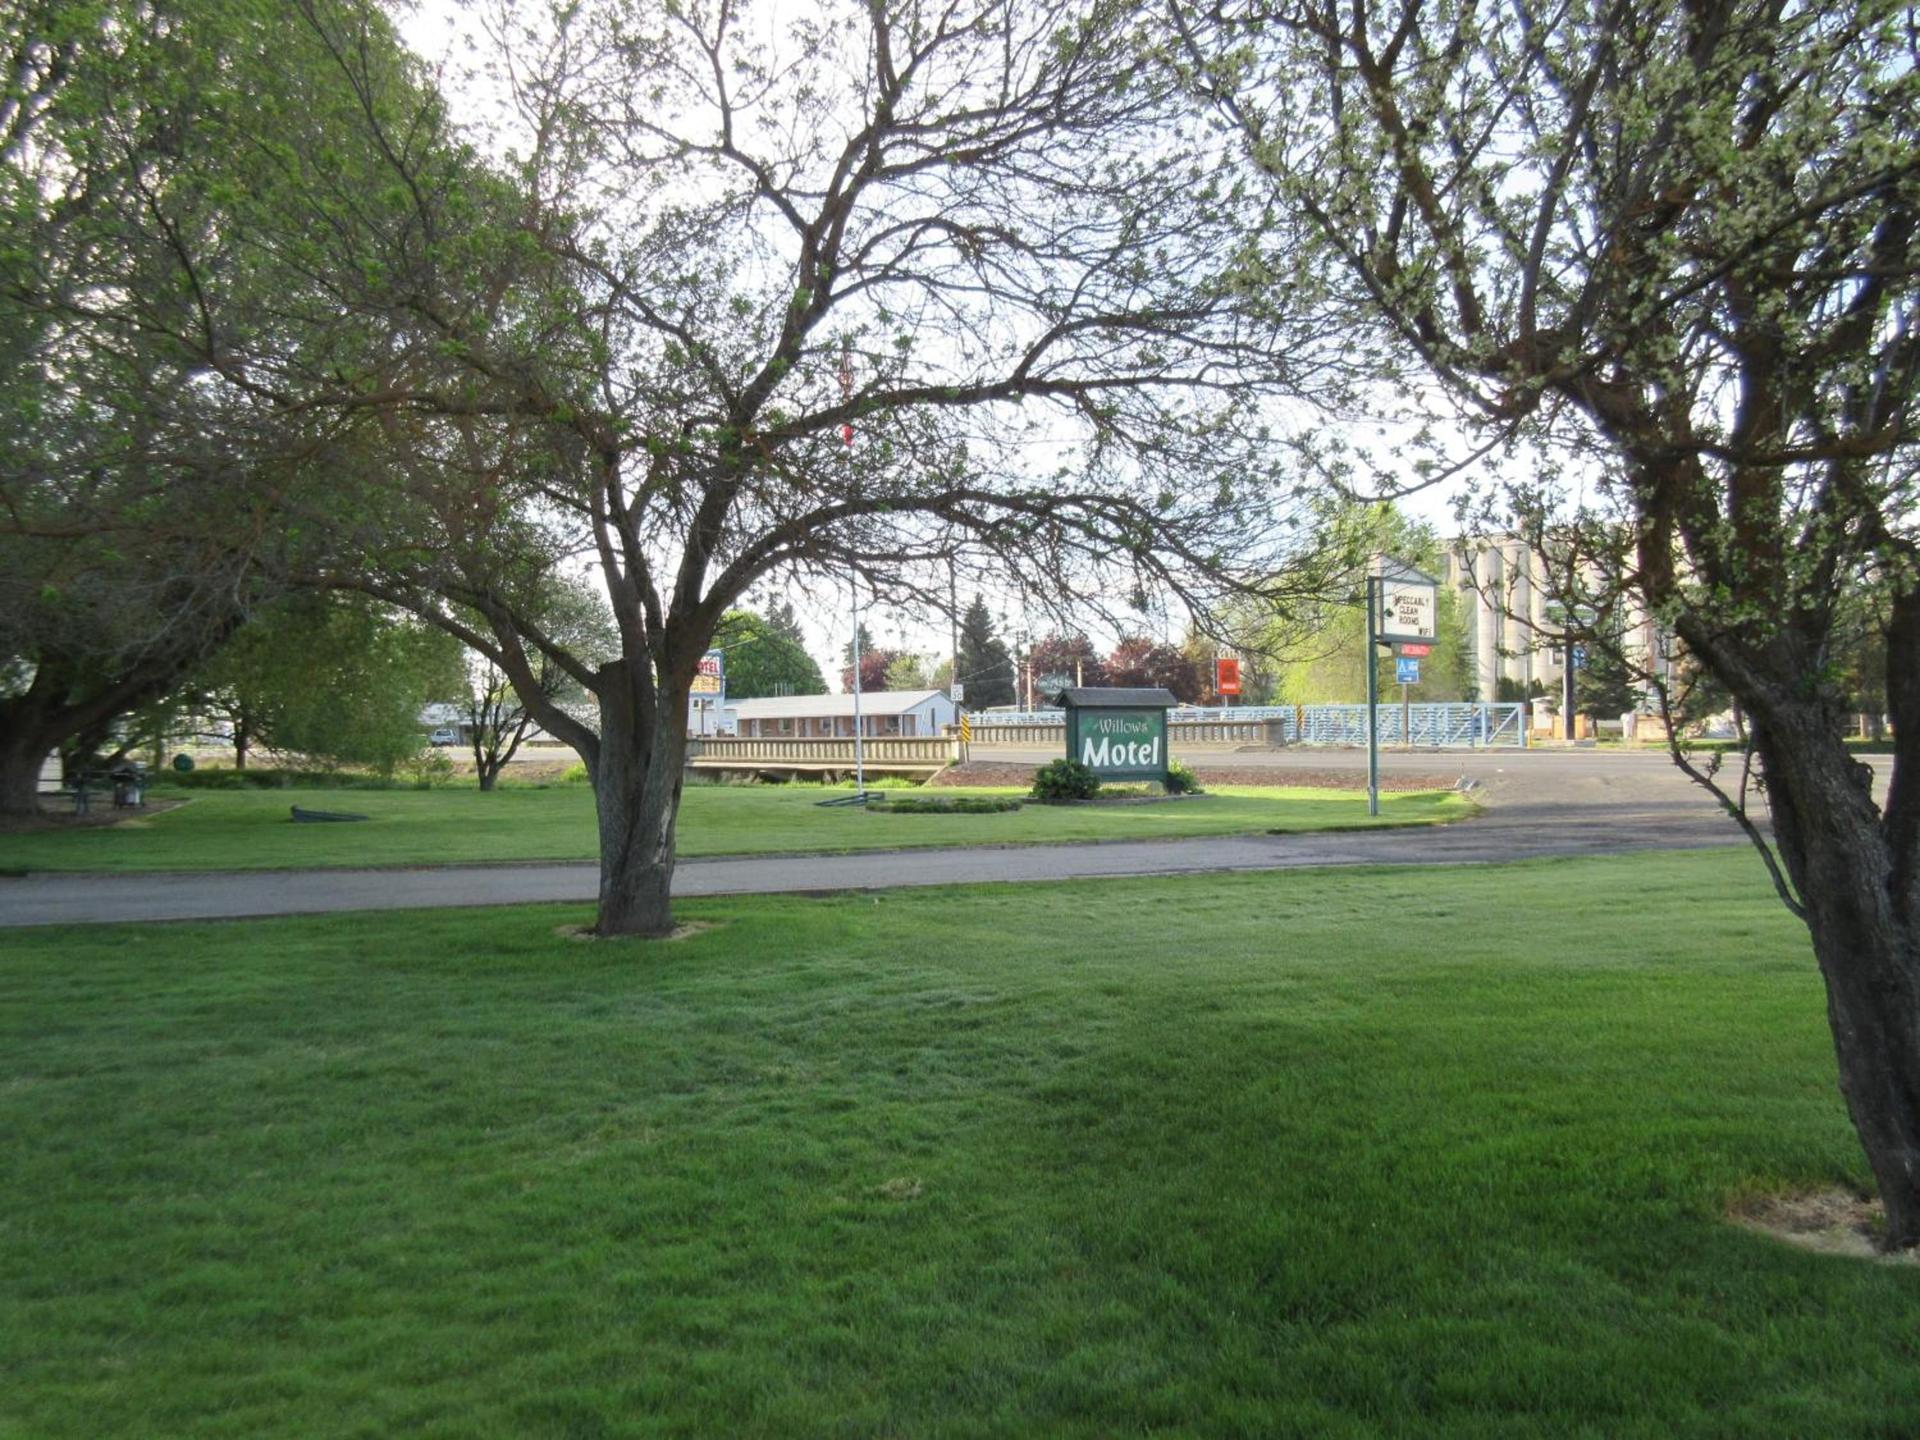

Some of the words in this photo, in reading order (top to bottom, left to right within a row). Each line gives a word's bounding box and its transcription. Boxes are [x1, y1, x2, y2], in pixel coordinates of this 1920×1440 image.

[696, 661, 718, 673] OTEL
[1099, 718, 1148, 734] Willows
[1082, 736, 1159, 767] Motel
